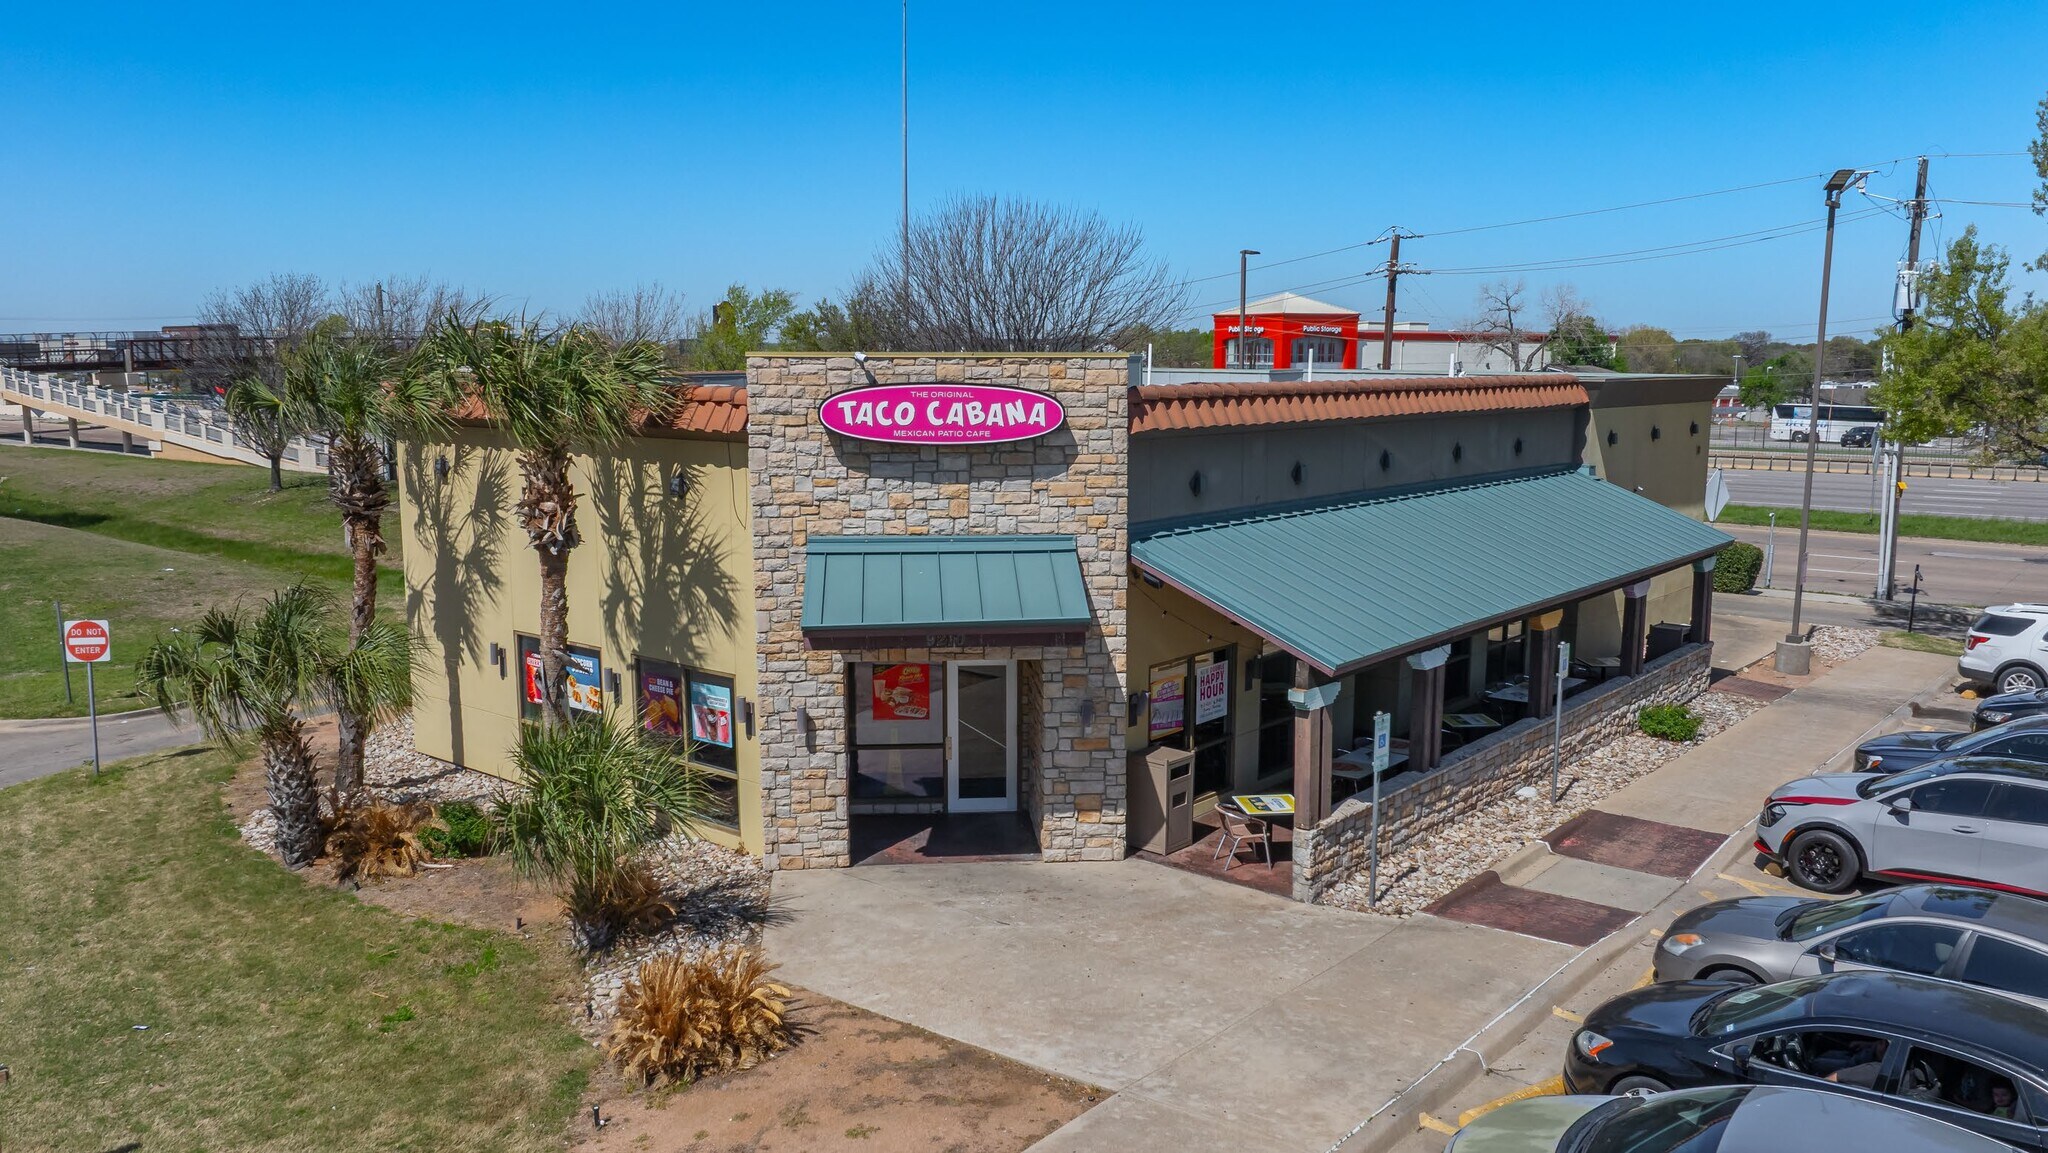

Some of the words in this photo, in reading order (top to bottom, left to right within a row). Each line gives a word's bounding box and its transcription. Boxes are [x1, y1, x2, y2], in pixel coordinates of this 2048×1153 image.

[1320, 325, 1342, 334] Storage
[838, 400, 916, 427] TACO
[926, 398, 1046, 427] CABANA
[937, 430, 964, 438] PATIO
[965, 430, 991, 438] CAFE
[71, 628, 82, 636] DO
[86, 628, 103, 636] NOT
[75, 646, 101, 655] ENTER
[656, 678, 670, 687] BEAN
[1200, 670, 1225, 688] HAPPY
[648, 684, 666, 694] CHEESE
[665, 687, 674, 696] PIE
[1200, 682, 1225, 701] HOUR
